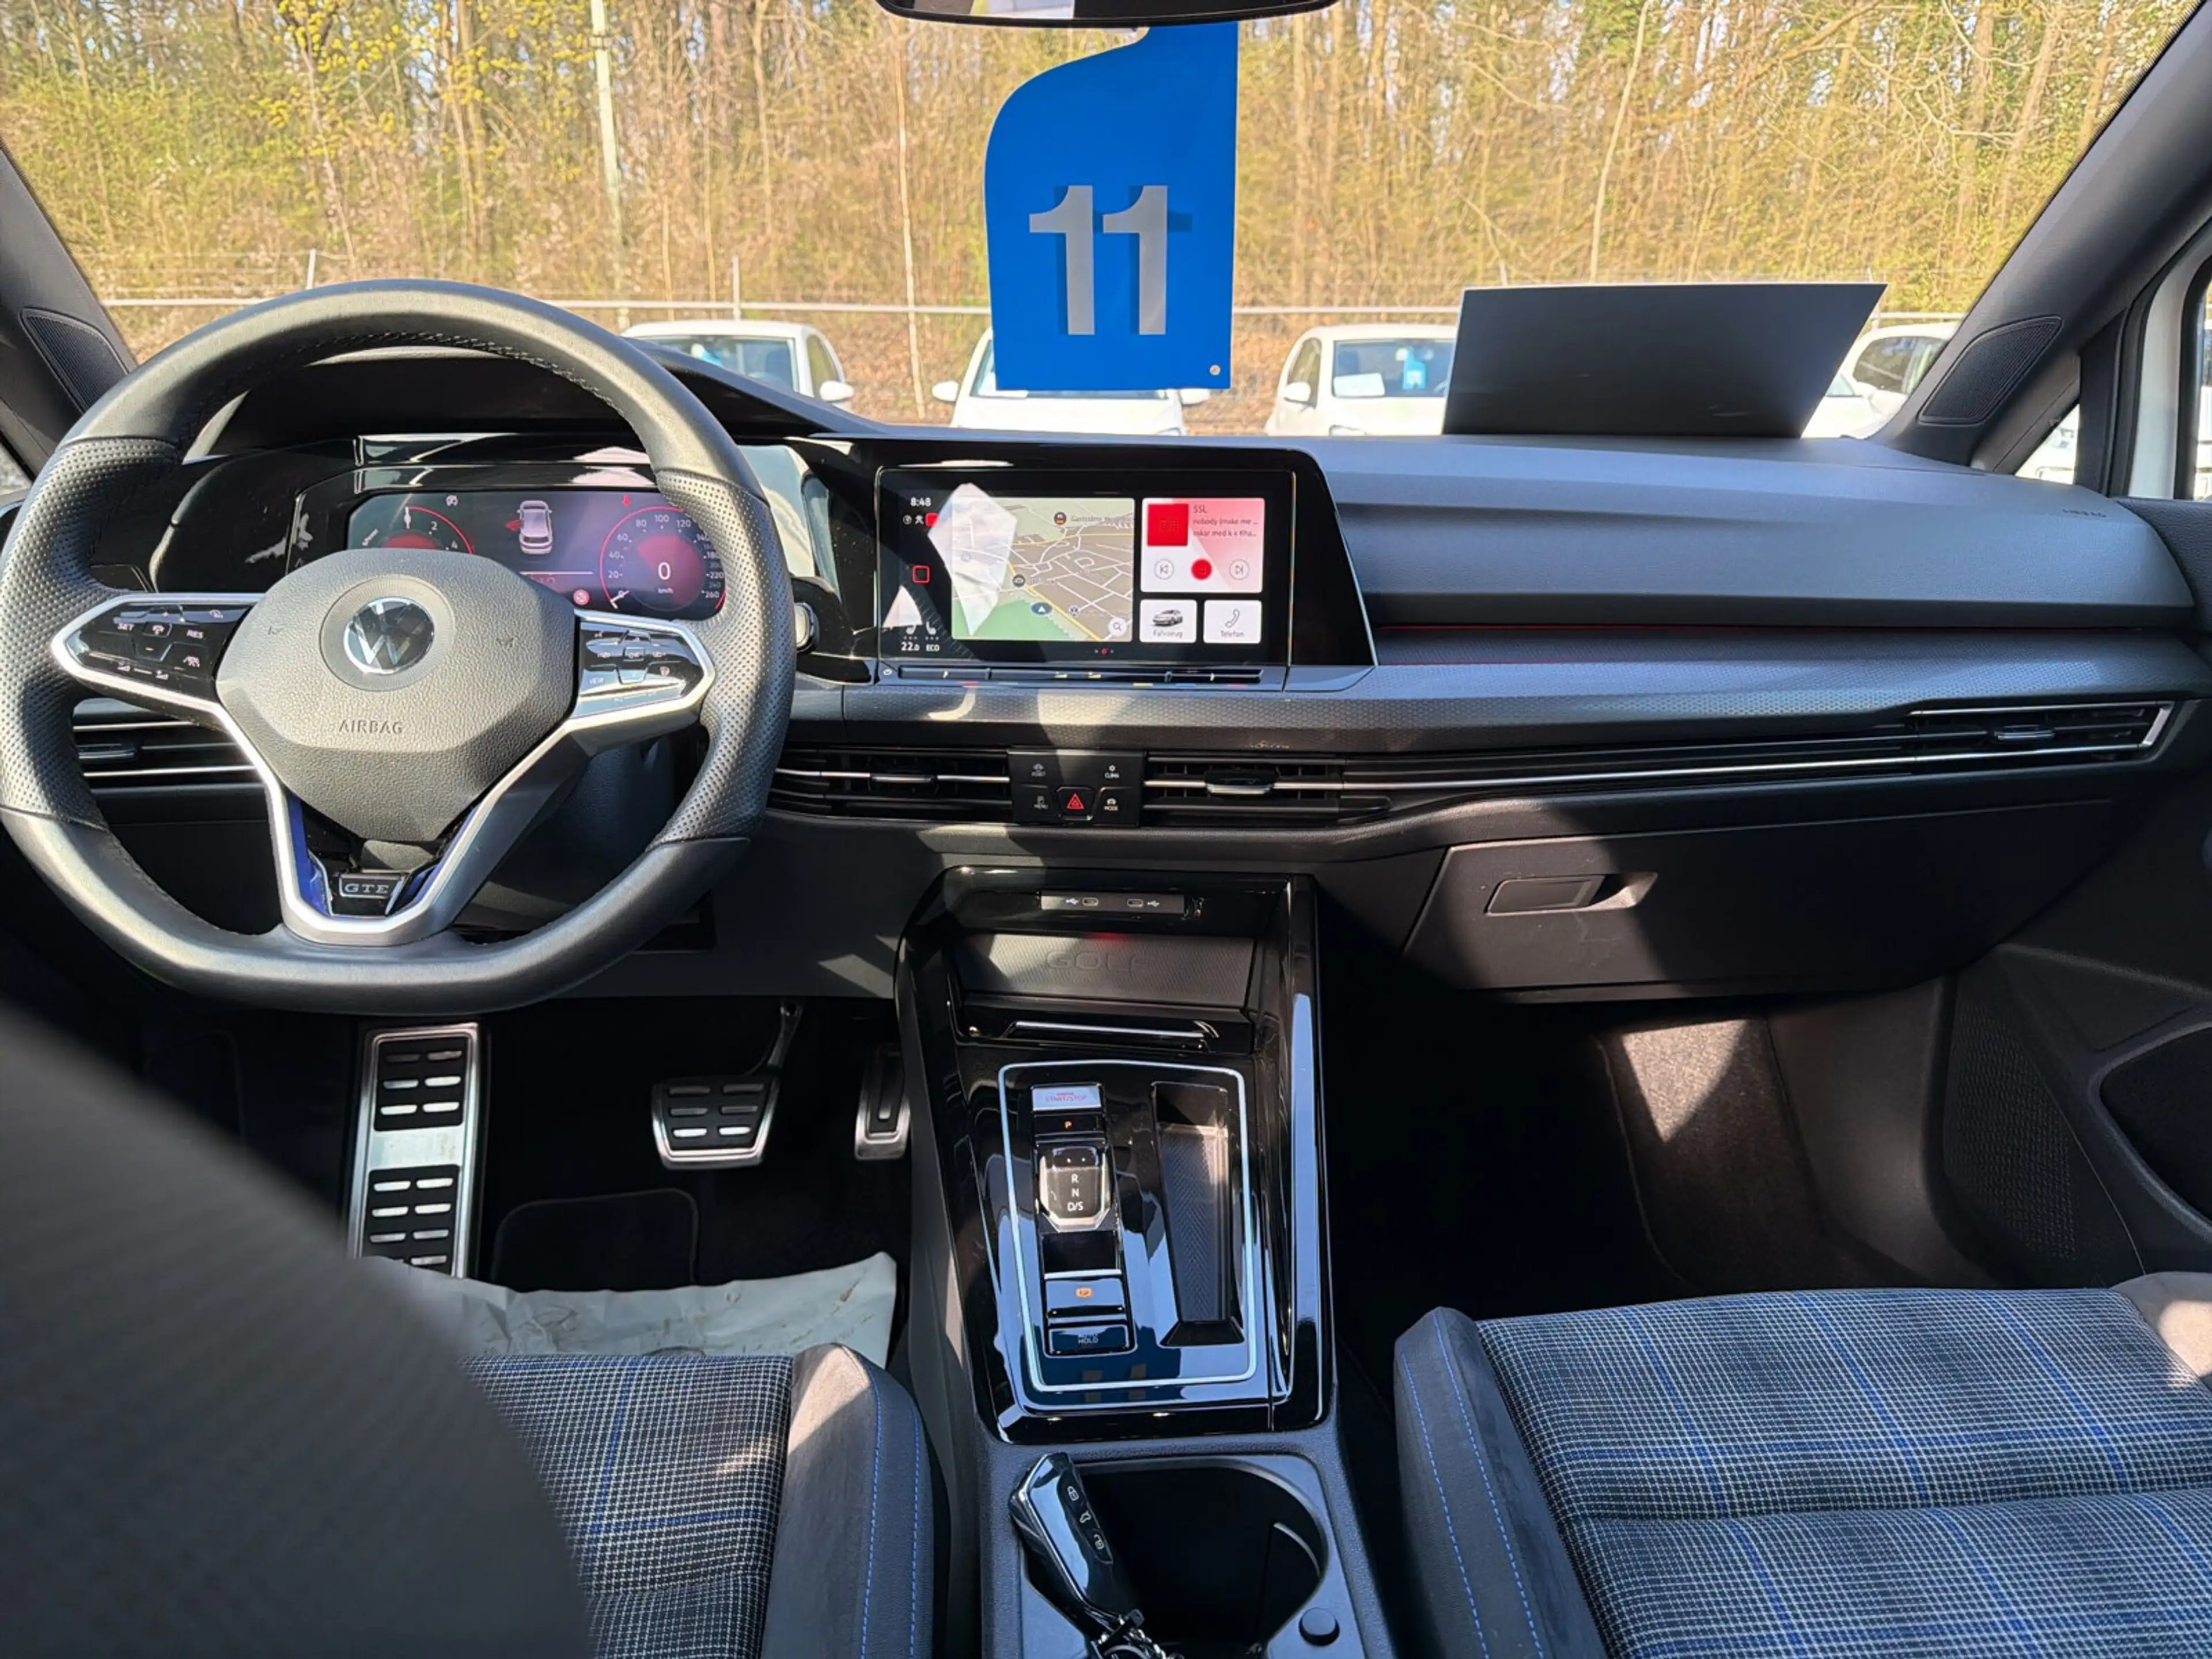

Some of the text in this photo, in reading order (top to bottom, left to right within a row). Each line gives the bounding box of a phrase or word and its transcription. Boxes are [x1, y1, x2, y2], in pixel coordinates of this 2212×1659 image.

[1029, 185, 1167, 335] 11
[911, 497, 931, 507] 8:48
[431, 521, 438, 531] 2
[636, 519, 647, 527] 80
[676, 520, 691, 528] 120
[617, 533, 628, 541] 60
[450, 541, 458, 550] 4
[609, 550, 620, 558] 40
[608, 570, 619, 579] 20
[658, 562, 671, 580] 0
[709, 571, 725, 579] 220
[118, 622, 135, 631] SET
[339, 719, 403, 734] AIRBAG
[344, 883, 389, 894] GTE
[1065, 1120, 1072, 1129] P
[1071, 1173, 1079, 1184] R
[1071, 1187, 1080, 1198] N
[1067, 1202, 1084, 1212] D/S
